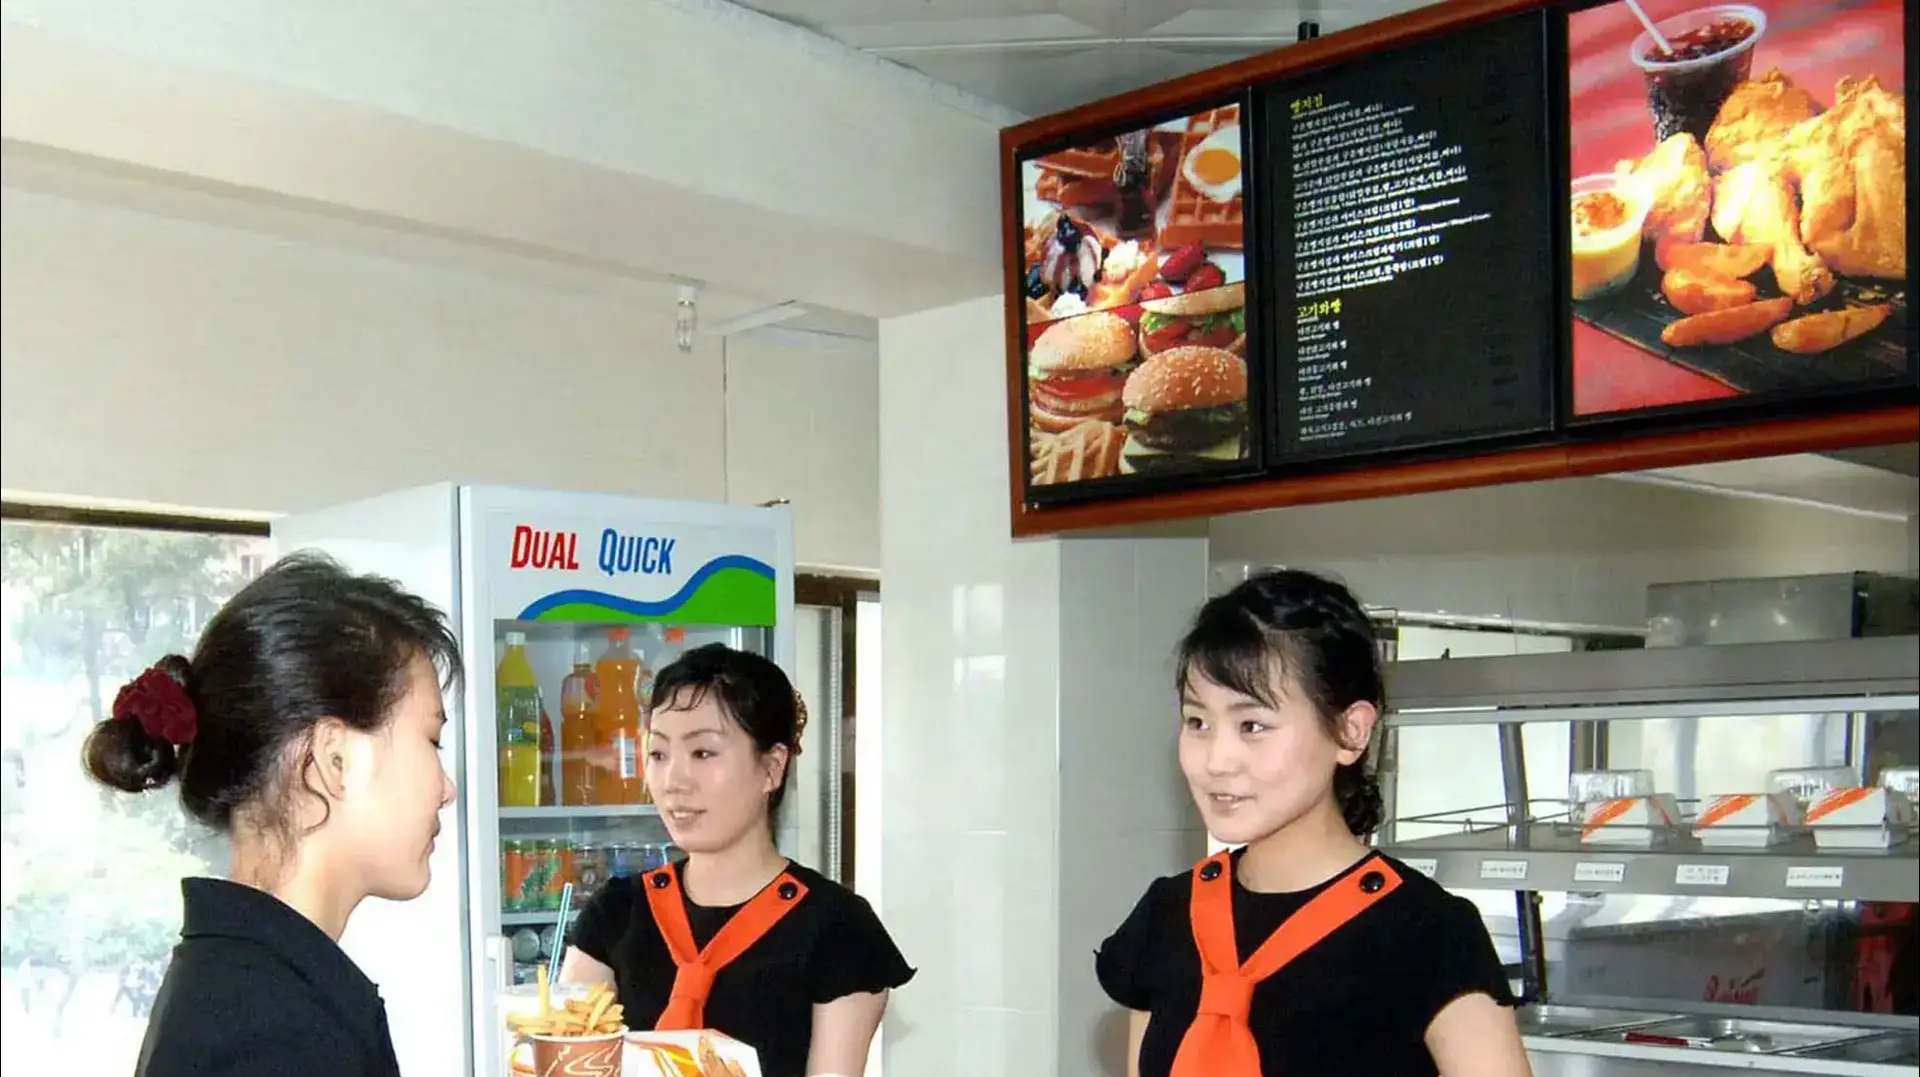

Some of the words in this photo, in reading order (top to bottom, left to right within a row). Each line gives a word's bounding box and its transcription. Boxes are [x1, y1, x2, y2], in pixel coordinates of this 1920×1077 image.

[1297, 298, 1342, 318] 고기와빵
[510, 524, 580, 571] DUAL
[598, 528, 676, 577] QUICK
